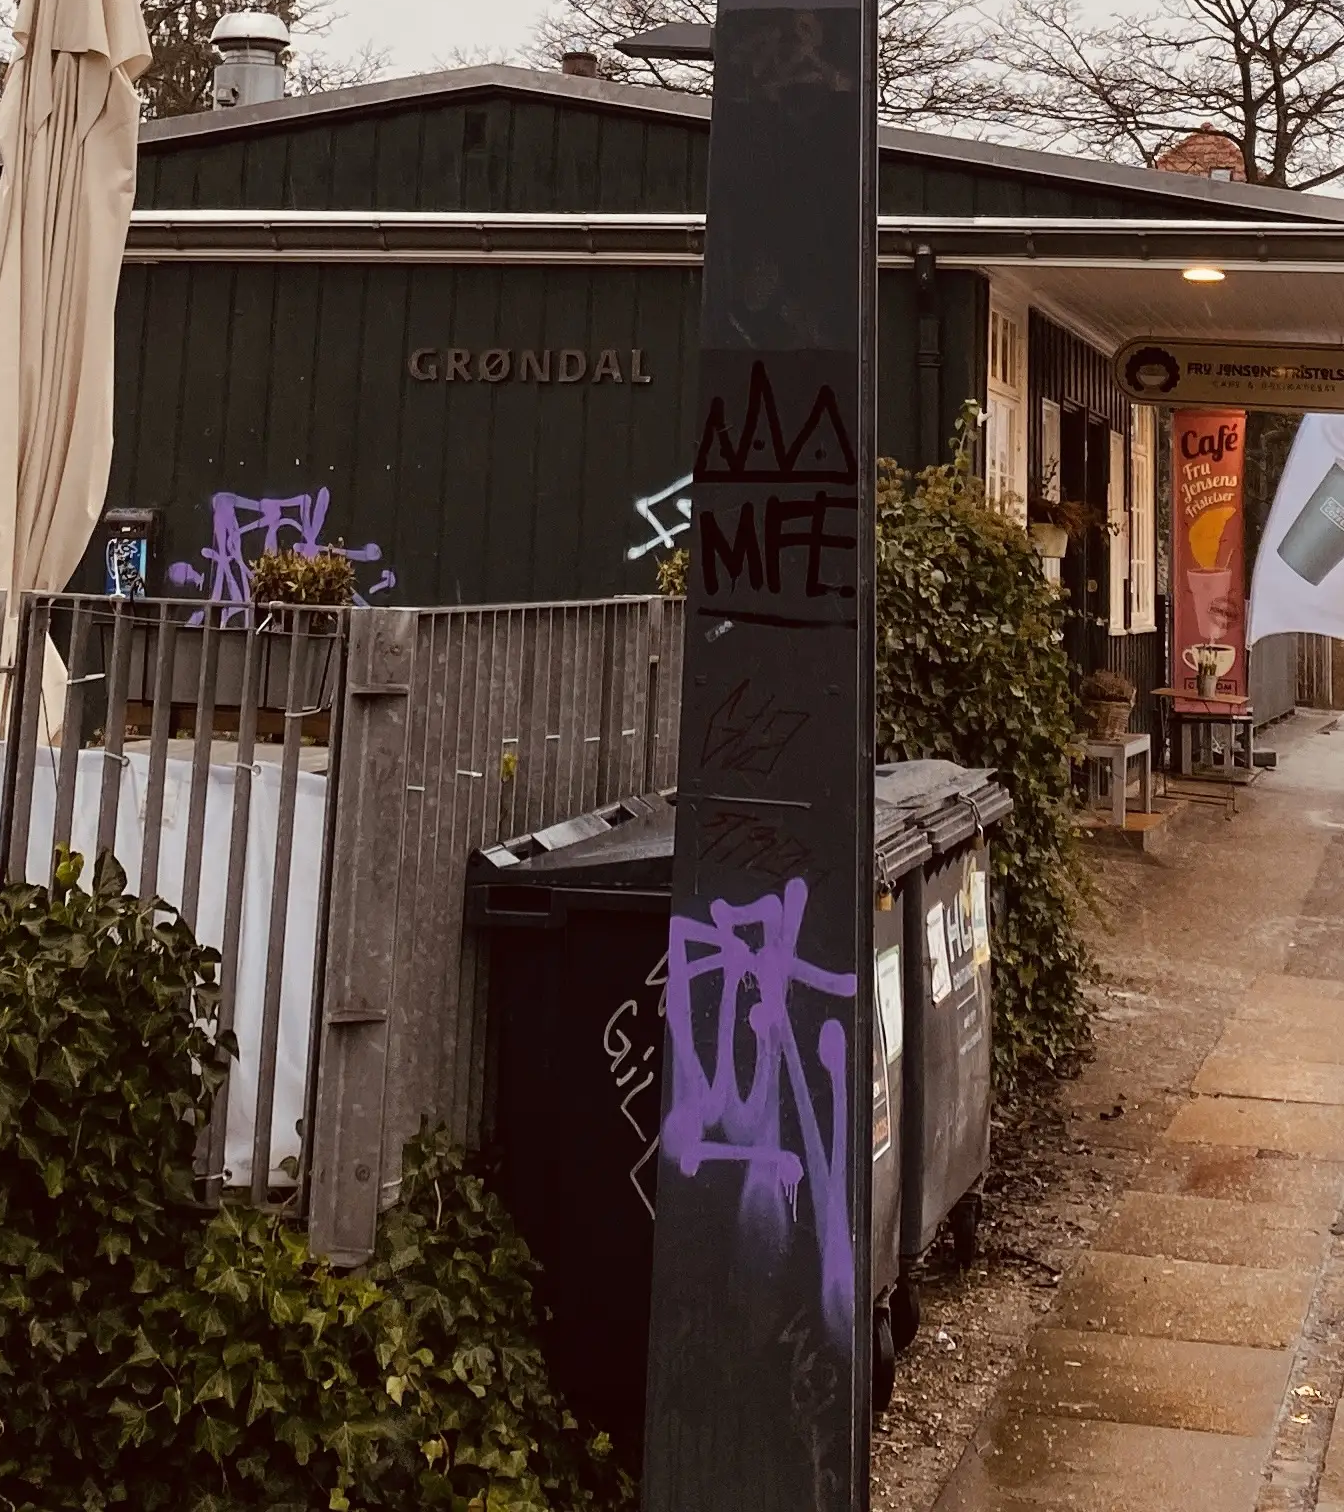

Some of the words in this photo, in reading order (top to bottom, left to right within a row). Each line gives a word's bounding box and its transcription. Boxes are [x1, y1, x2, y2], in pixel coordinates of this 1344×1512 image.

[408, 347, 652, 383] GRØNDAL
[1181, 423, 1238, 462] Café
[1183, 462, 1211, 481] Fru
[1181, 475, 1238, 504] Jensens
